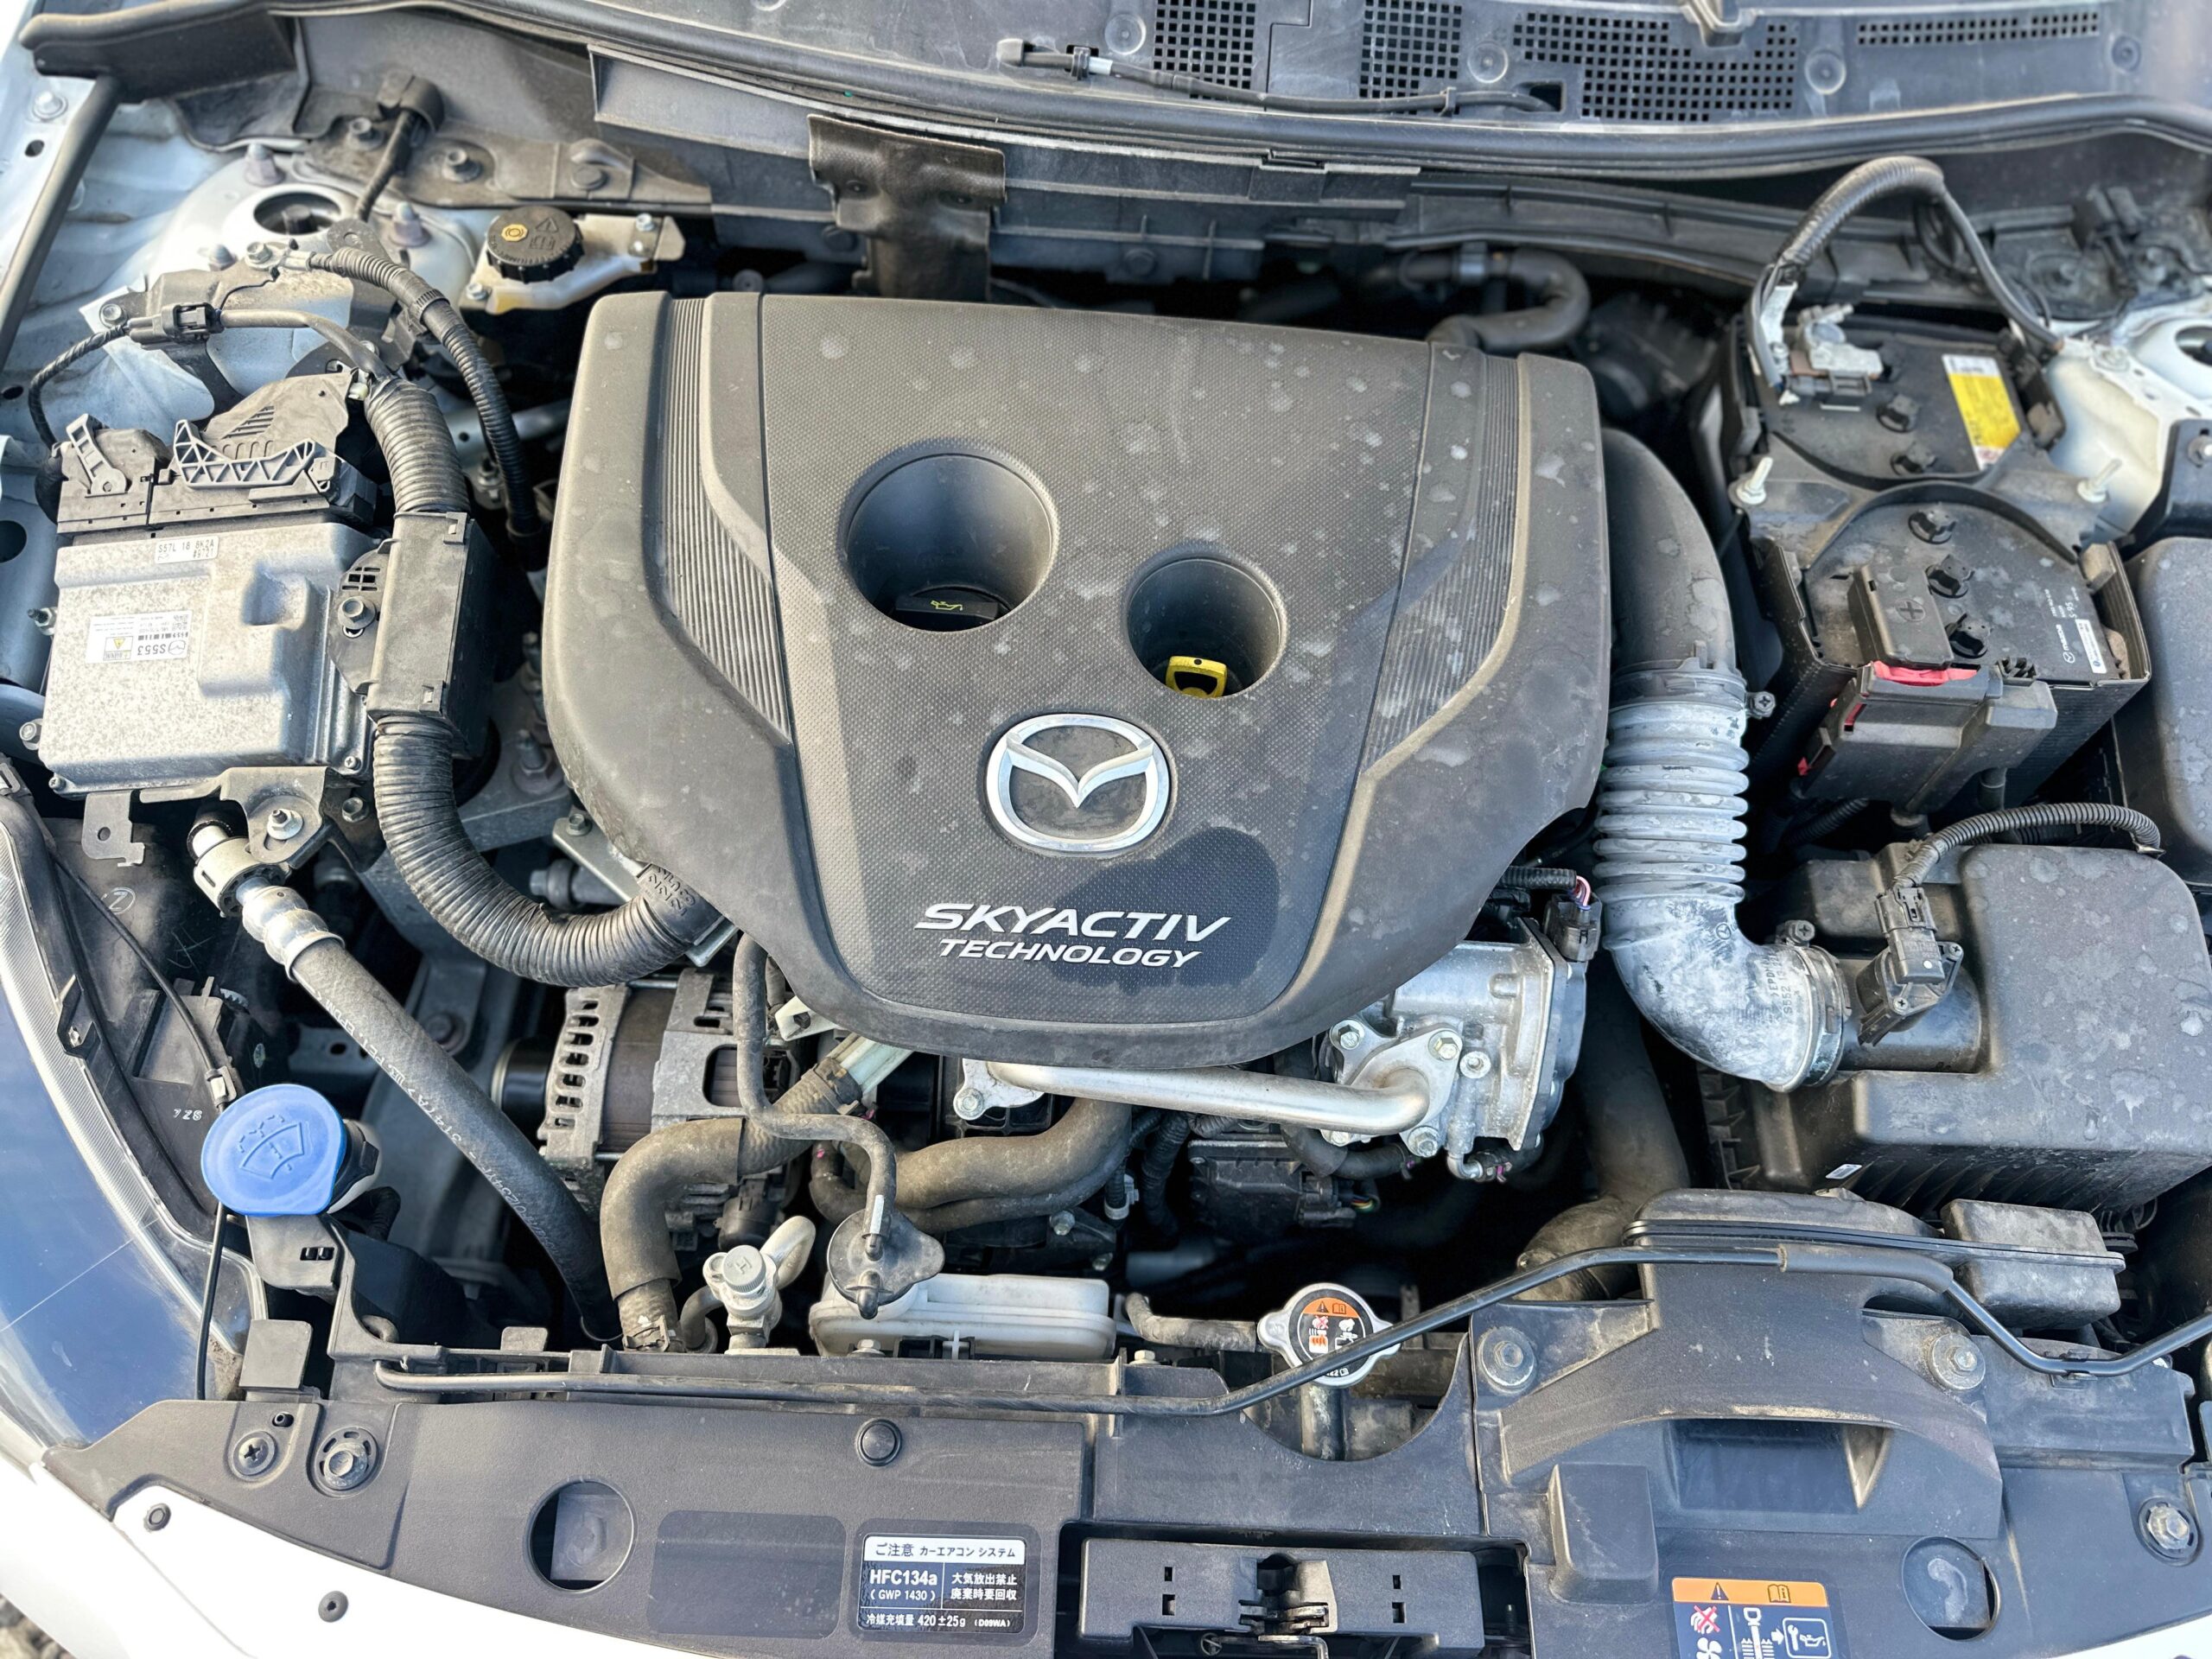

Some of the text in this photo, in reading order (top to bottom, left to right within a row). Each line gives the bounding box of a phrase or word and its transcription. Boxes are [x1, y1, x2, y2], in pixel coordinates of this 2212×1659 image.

[137, 644, 167, 656] S553
[914, 903, 1231, 942] SKYACTIV
[939, 938, 1204, 968] TECHNOLOGY
[875, 1542, 914, 1557] ご注意
[869, 1569, 938, 1586] HFC134a
[951, 1573, 1018, 1586] 大気放出禁止
[950, 1588, 1017, 1601] 廃棄時要回収
[866, 1613, 914, 1626] 冷媒充填量
